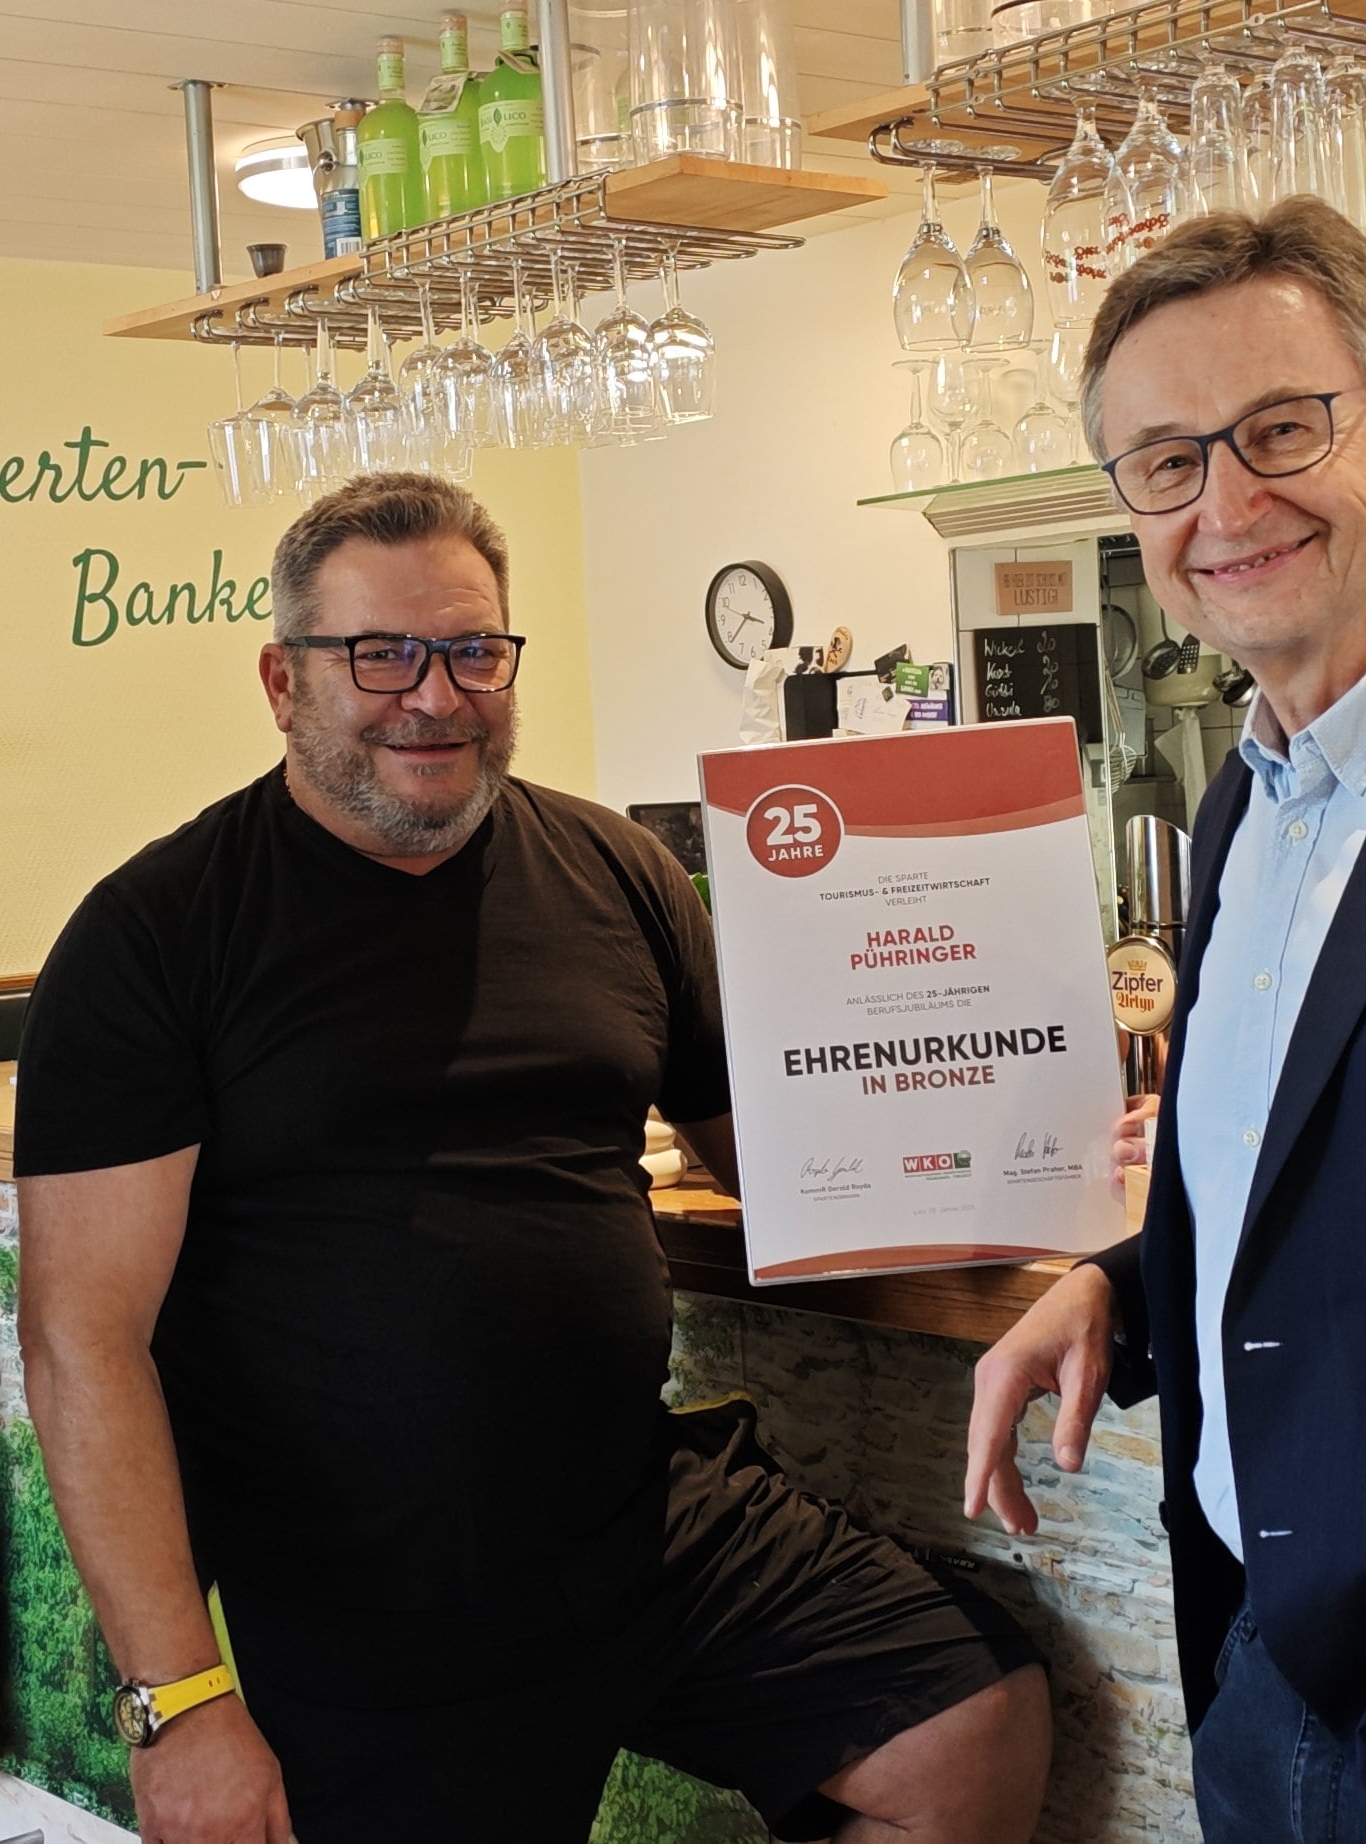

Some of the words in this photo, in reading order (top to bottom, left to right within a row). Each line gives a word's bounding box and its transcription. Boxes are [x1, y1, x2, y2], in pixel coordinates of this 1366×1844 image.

[503, 112, 527, 122] LICO
[763, 803, 822, 846] 25
[767, 844, 824, 862] JAHRE
[877, 874, 893, 885] DIE
[895, 871, 929, 883] SPARTE
[819, 888, 879, 901] TOURISMUS-
[881, 887, 889, 896] &
[891, 877, 991, 895] FREIZEITWIRTSCHAFT
[885, 895, 927, 907] VERLEIHT
[867, 924, 955, 948] HARALD
[850, 943, 977, 971] PÜHRINGER
[1111, 971, 1163, 995] Zipfer
[846, 991, 904, 1006] ANLÄSSLICH
[906, 990, 925, 1001] DES
[926, 985, 991, 998] 25-JÄHRIGEN
[1115, 992, 1155, 1013] Urtyp
[867, 999, 955, 1016] BERUFSJUBILÄUMS
[957, 998, 972, 1008] DIE
[784, 1025, 1067, 1077] EHRENURKUNDE
[861, 1075, 887, 1096] IN
[895, 1064, 995, 1093] BRONZE
[903, 1155, 951, 1171] WKO
[1020, 1167, 1041, 1176] Stefan
